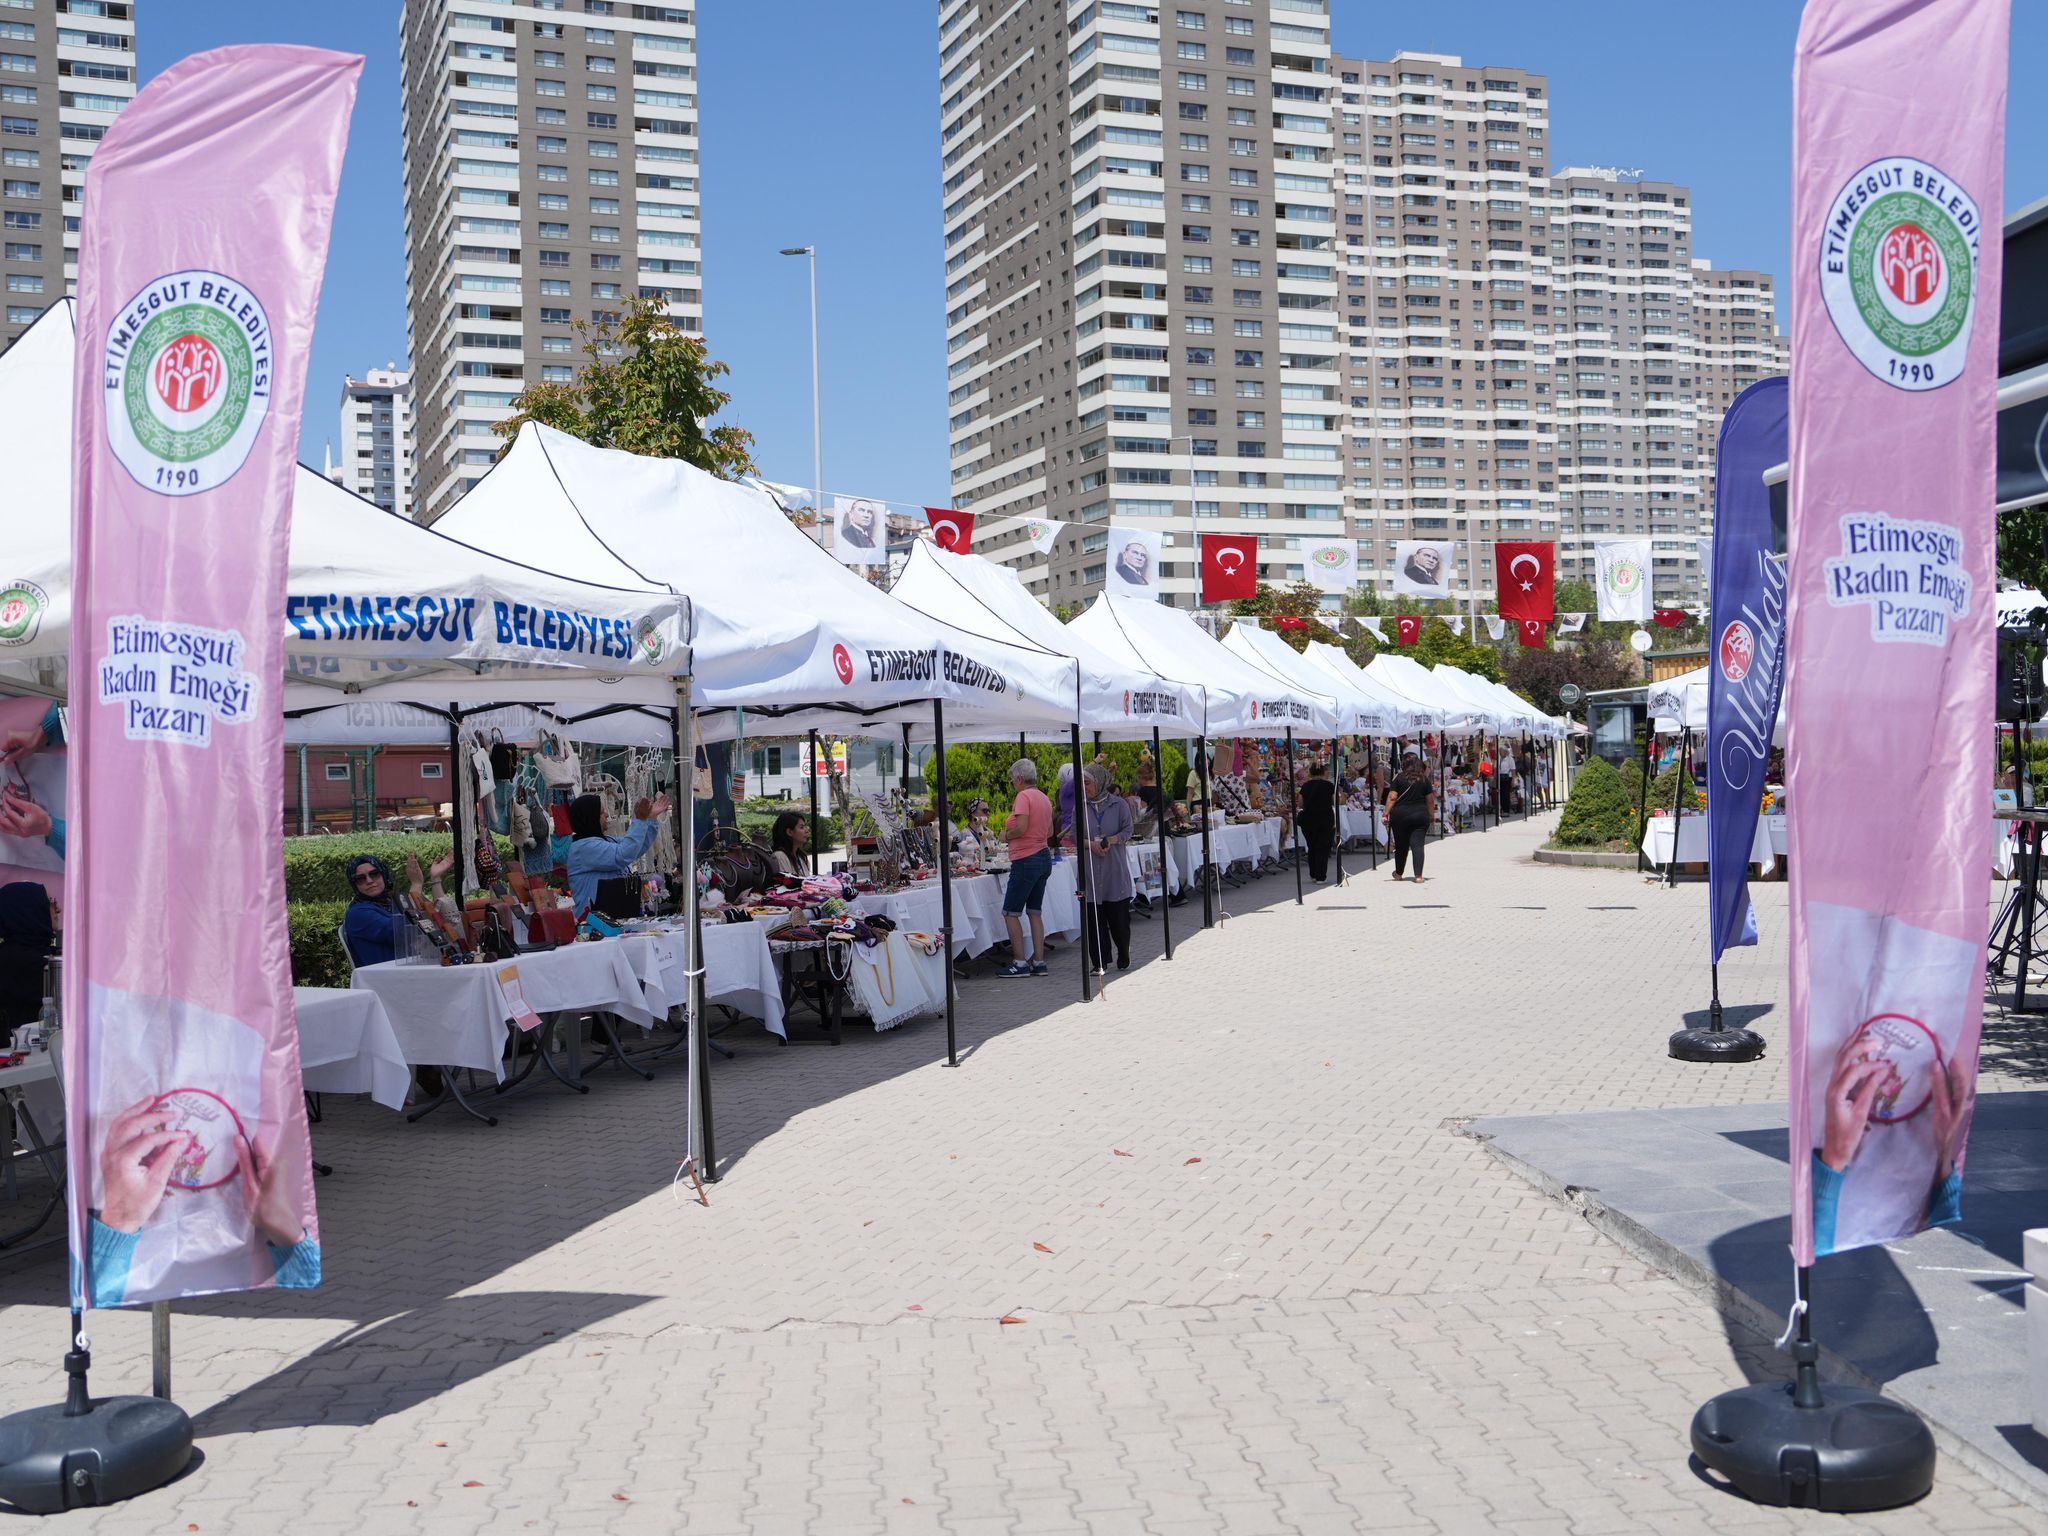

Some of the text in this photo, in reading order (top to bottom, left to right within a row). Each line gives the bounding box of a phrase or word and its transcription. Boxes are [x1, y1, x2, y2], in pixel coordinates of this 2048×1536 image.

[1828, 168, 1902, 273] ETİMESGUT
[106, 281, 269, 398] ETİMESGUT BELEDİYESİ
[1888, 358, 1935, 383] 1990
[155, 466, 199, 488] 1990
[1834, 563, 1909, 598] Kadın
[286, 593, 476, 642] ETİMESGUT
[493, 600, 633, 660] BELEDİYESİ
[1878, 600, 1944, 635] Pazarı
[113, 624, 234, 667] Etimesgut
[103, 663, 156, 696] Kadın
[169, 664, 251, 716] Emeği
[130, 699, 205, 736] Pazarı
